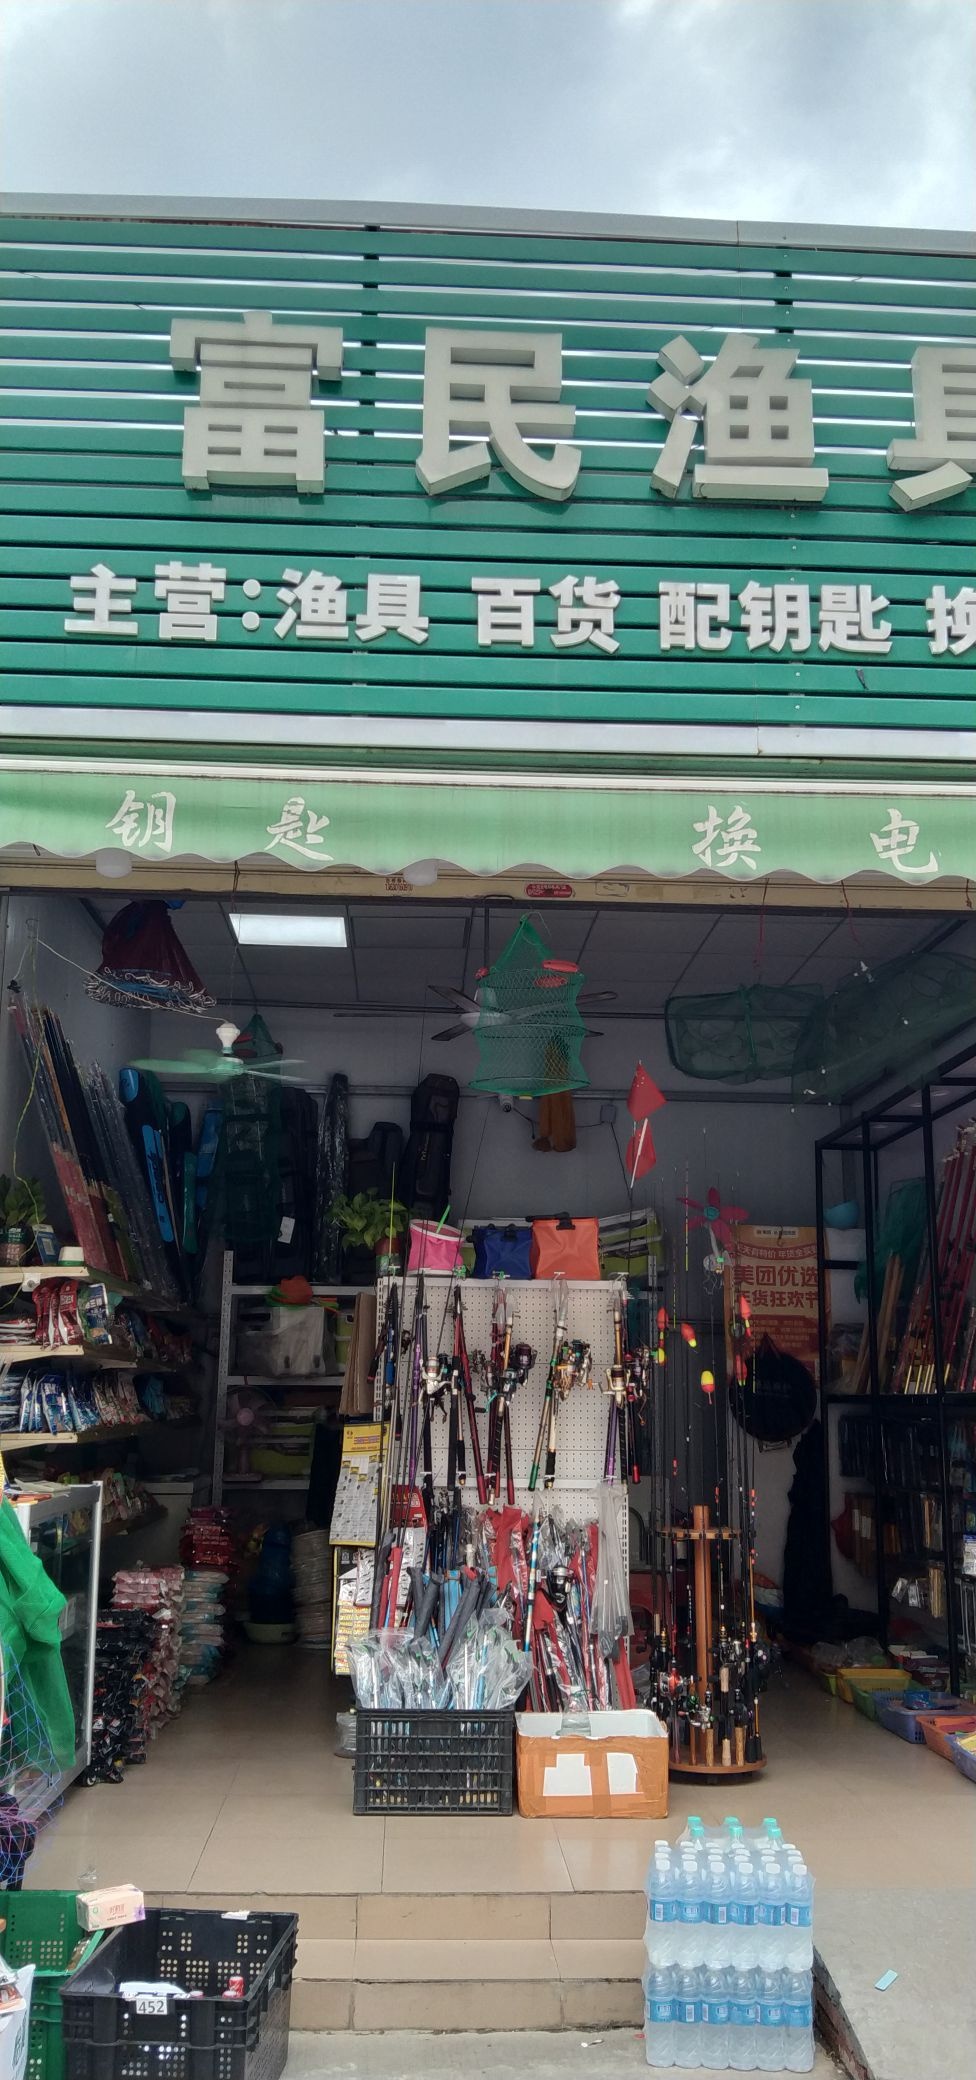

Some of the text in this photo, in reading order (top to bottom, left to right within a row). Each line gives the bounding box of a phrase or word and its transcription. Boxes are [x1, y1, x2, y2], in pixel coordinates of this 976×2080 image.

[471, 576, 620, 654] 百货
[658, 580, 893, 653] 配钥匙
[733, 1265, 818, 1287] 美团优选
[138, 2000, 165, 2014] 452
